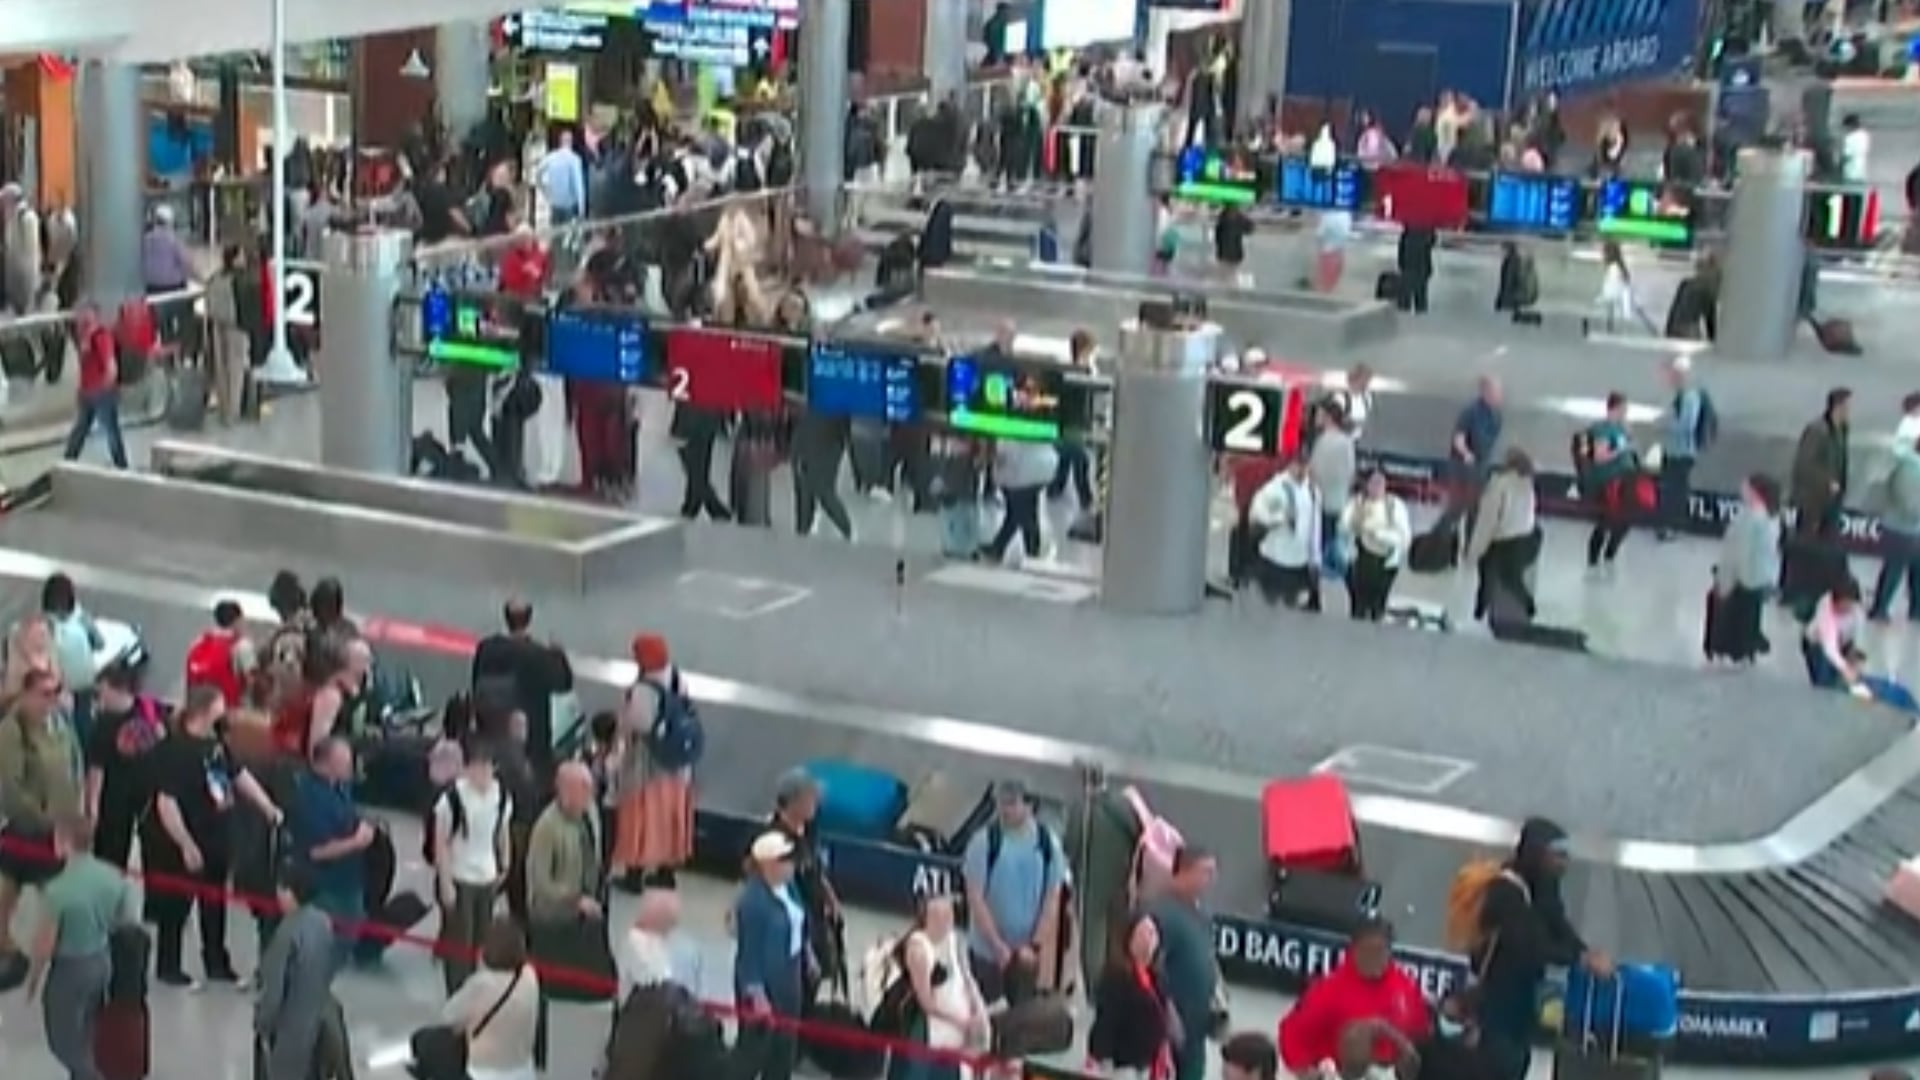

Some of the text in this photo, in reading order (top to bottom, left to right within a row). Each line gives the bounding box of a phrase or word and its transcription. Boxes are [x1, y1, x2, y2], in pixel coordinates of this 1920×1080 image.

[1827, 194, 1843, 239] 1
[284, 271, 315, 325] 2
[671, 367, 690, 401] 2
[1223, 390, 1266, 451] 2
[1244, 929, 1301, 972] BAG
